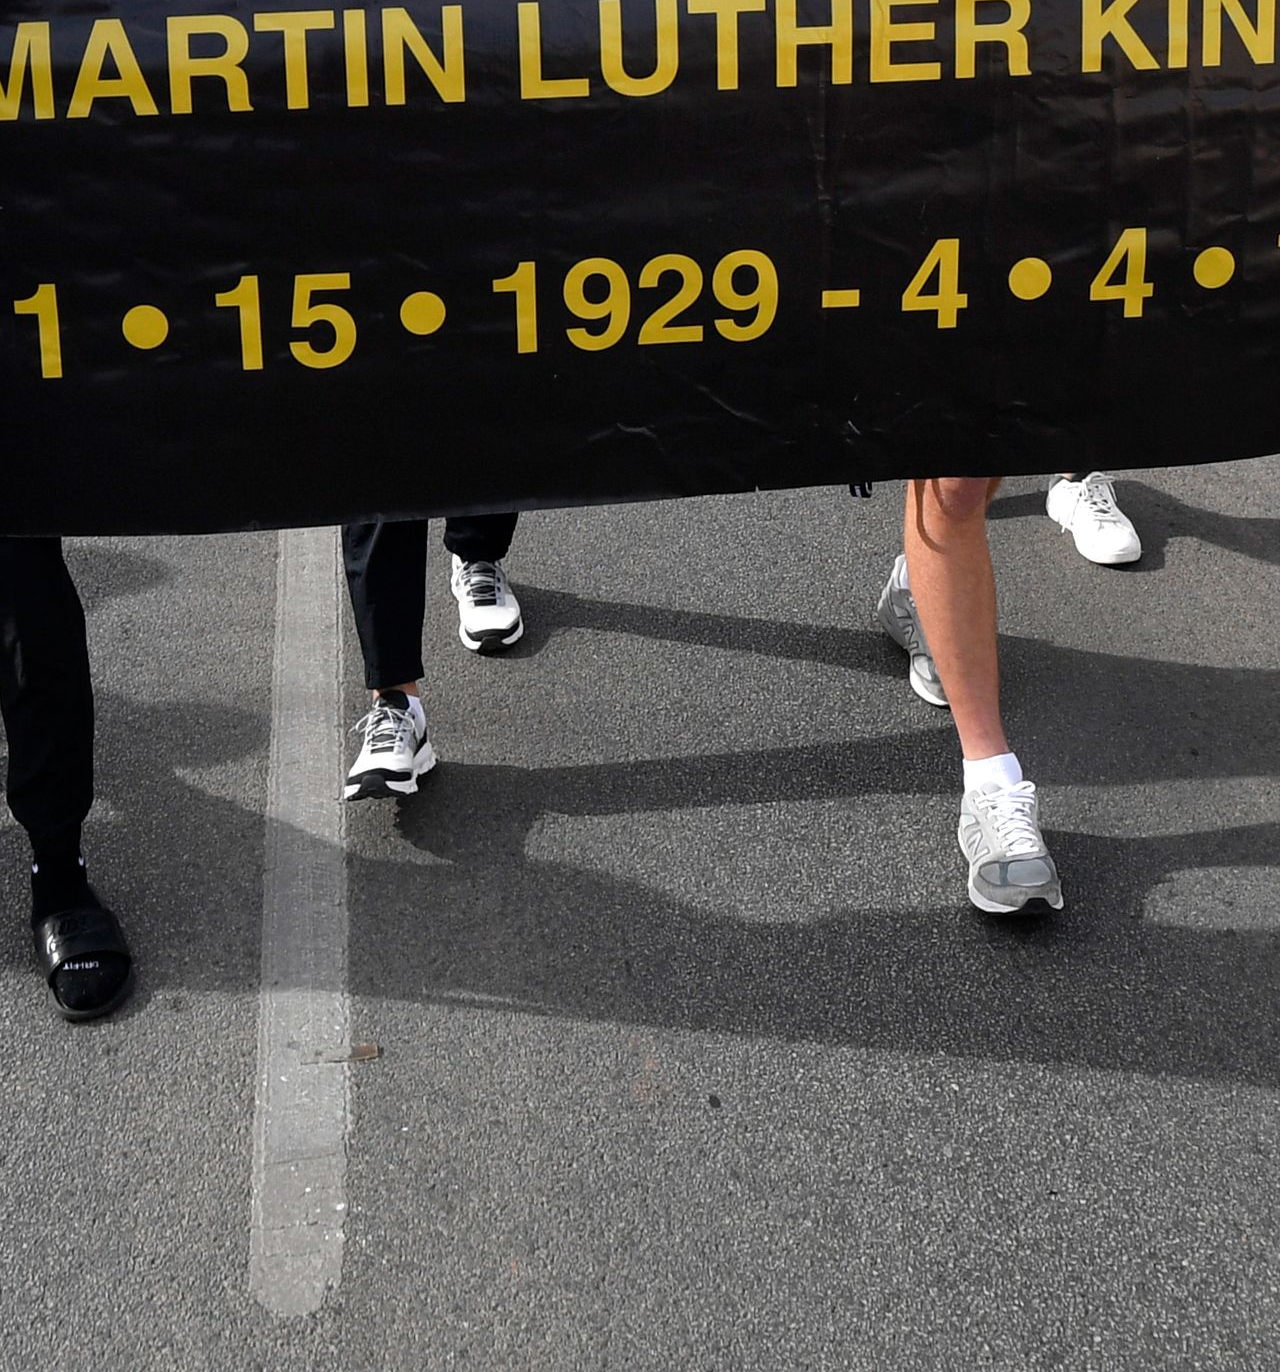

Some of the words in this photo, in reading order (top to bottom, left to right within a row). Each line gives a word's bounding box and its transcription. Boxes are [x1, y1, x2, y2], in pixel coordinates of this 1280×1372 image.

[13, 283, 63, 379] 1
[215, 272, 357, 371] 15
[492, 249, 780, 354] 1929
[901, 238, 968, 329] 4
[1089, 227, 1154, 318] 4
